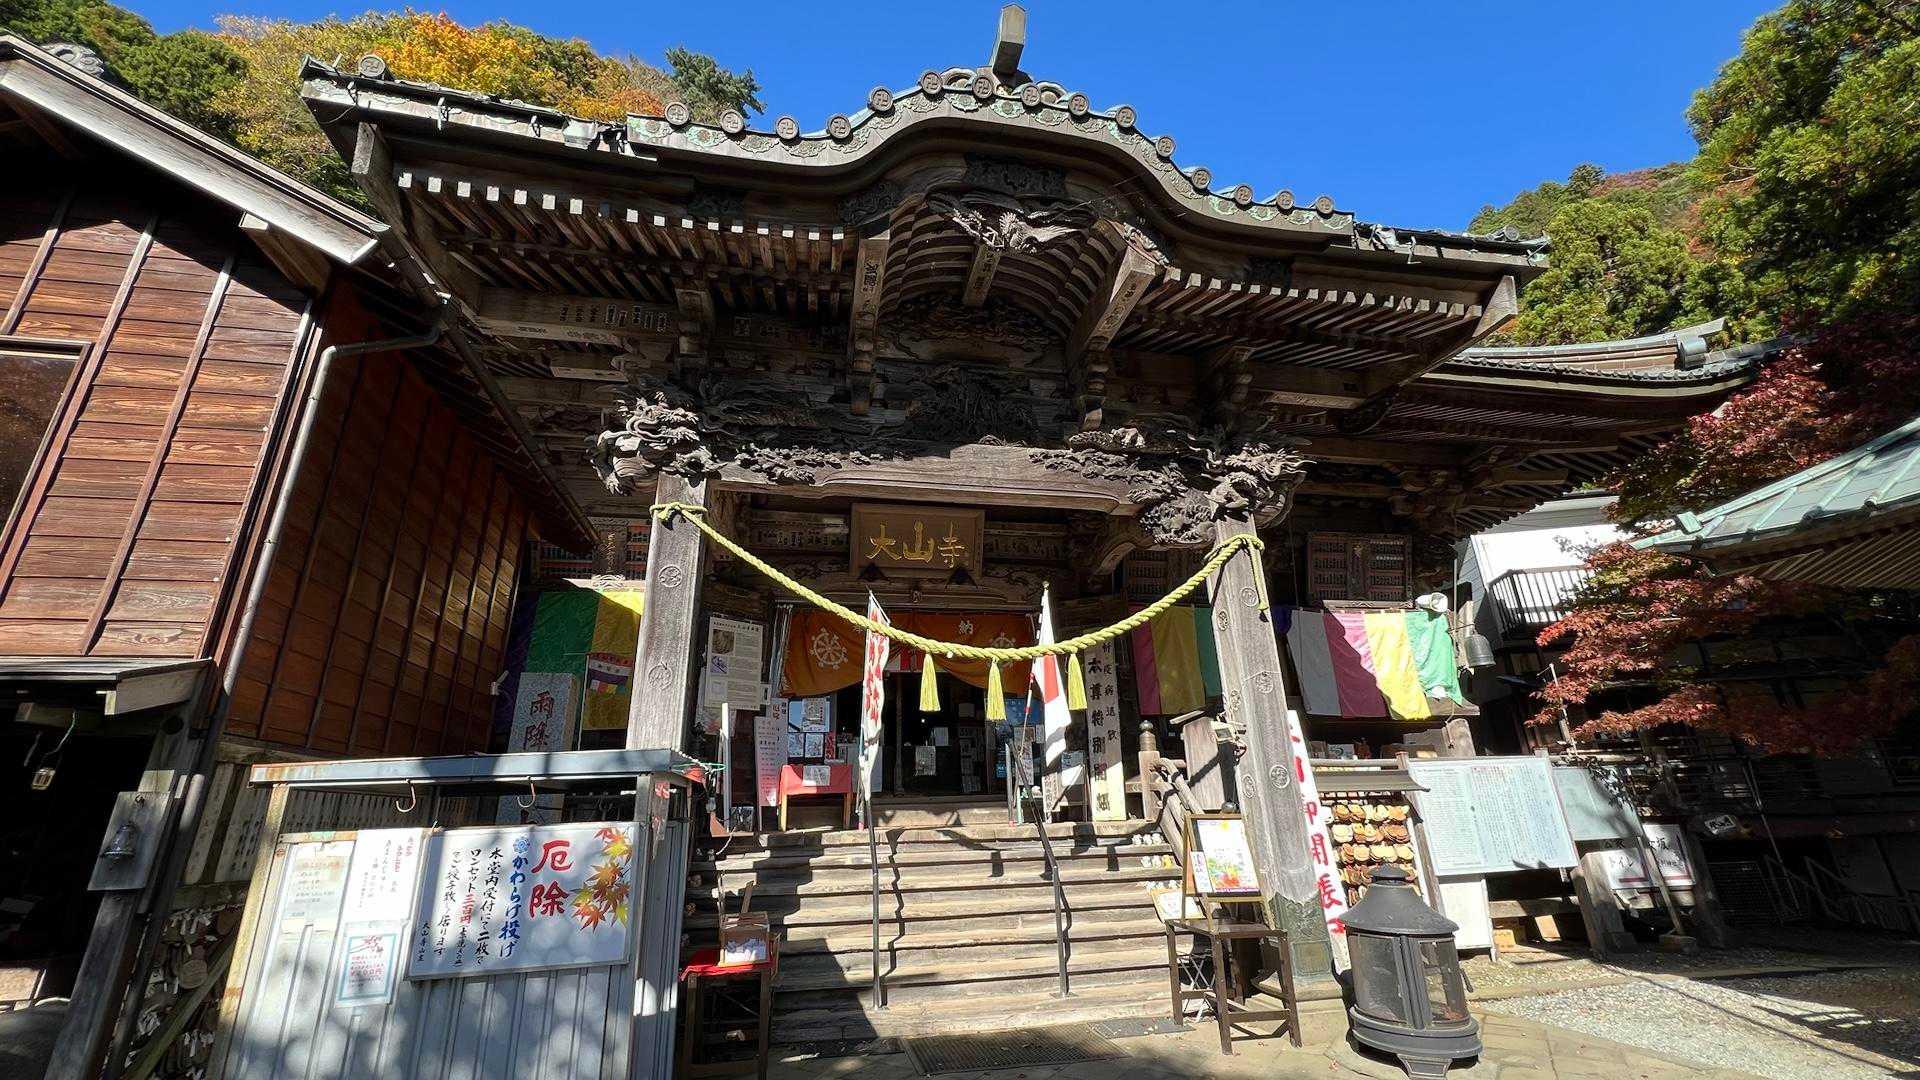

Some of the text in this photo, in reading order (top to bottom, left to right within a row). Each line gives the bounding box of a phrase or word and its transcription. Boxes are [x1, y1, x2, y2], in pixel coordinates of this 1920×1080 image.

[864, 519, 967, 568] 大山寺
[499, 856, 530, 958] かわらけ投げ
[529, 840, 573, 919] 厄除
